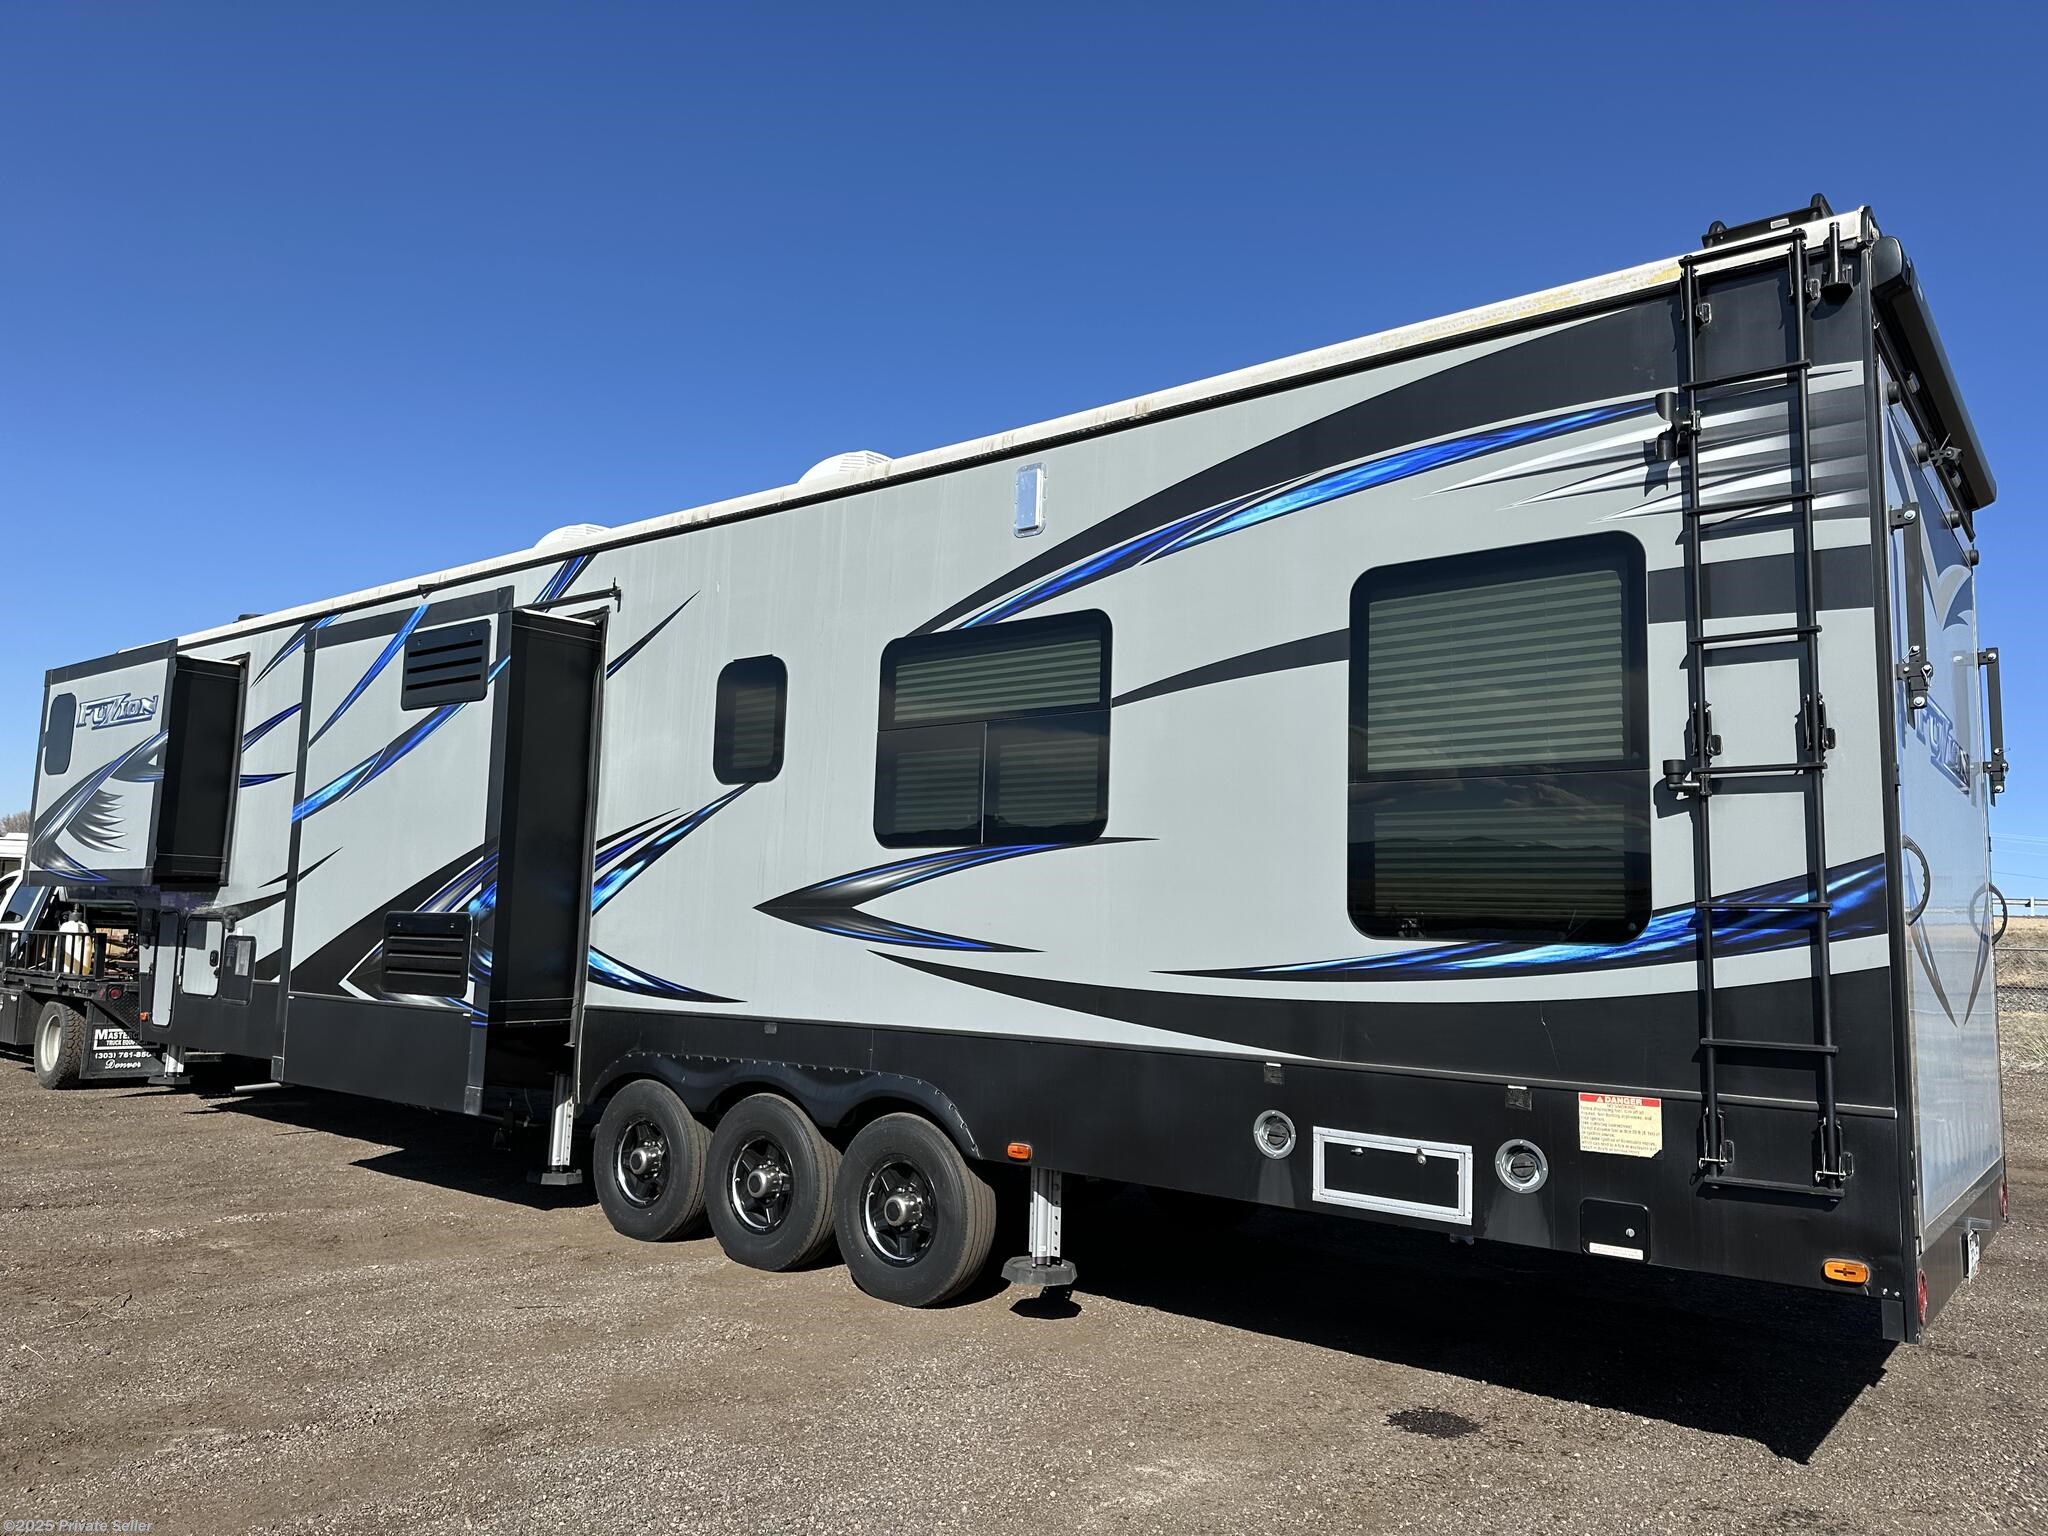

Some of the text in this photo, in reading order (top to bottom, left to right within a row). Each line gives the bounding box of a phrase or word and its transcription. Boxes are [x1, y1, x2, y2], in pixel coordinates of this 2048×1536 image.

[76, 693, 159, 730] FUZION
[105, 1059, 141, 1069] Denver
[1605, 1095, 1642, 1106] DANGER
